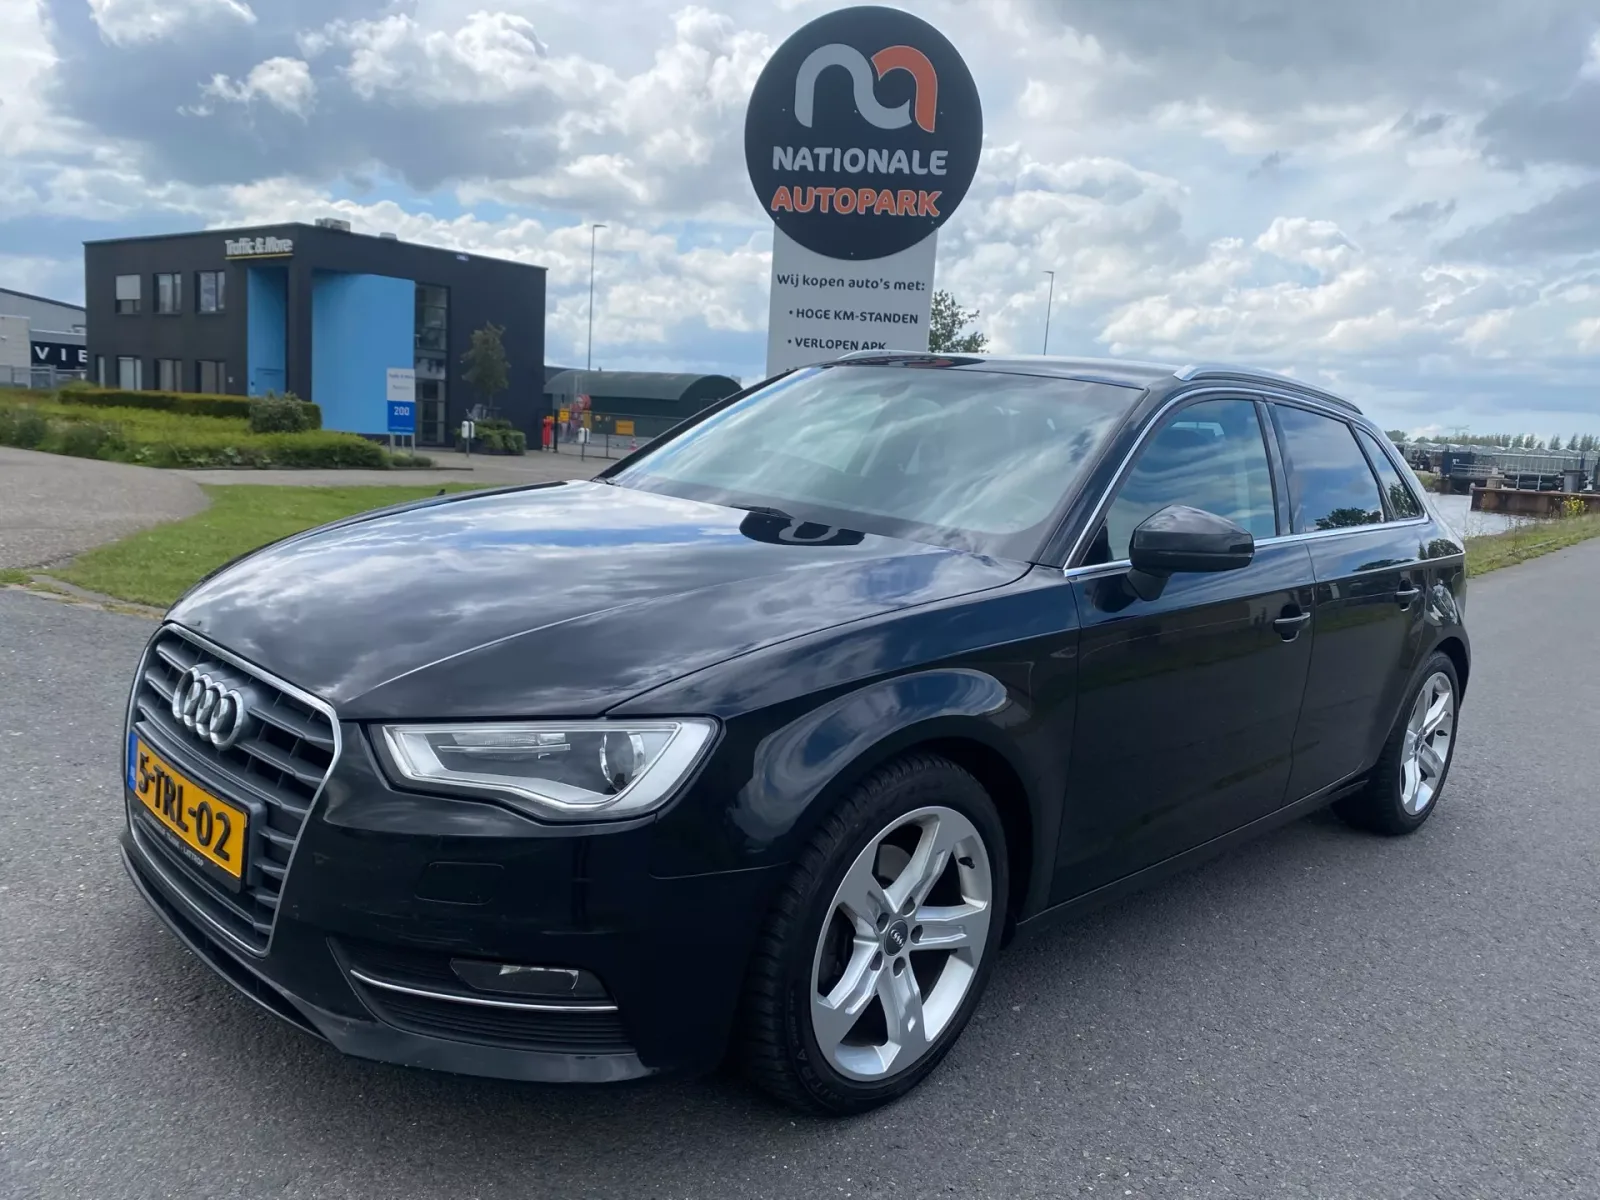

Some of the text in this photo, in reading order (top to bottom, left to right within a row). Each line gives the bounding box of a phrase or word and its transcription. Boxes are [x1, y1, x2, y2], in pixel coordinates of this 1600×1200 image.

[772, 146, 949, 175] NATIONALE
[771, 185, 942, 217] AUTOPARK
[777, 274, 925, 291] Wij kopen auto's met:
[796, 308, 918, 324] HOGE KM-STANDEN
[795, 337, 887, 350] VERLOPEN APK
[393, 406, 410, 416] 200
[138, 751, 231, 862] 5-TRL-02
